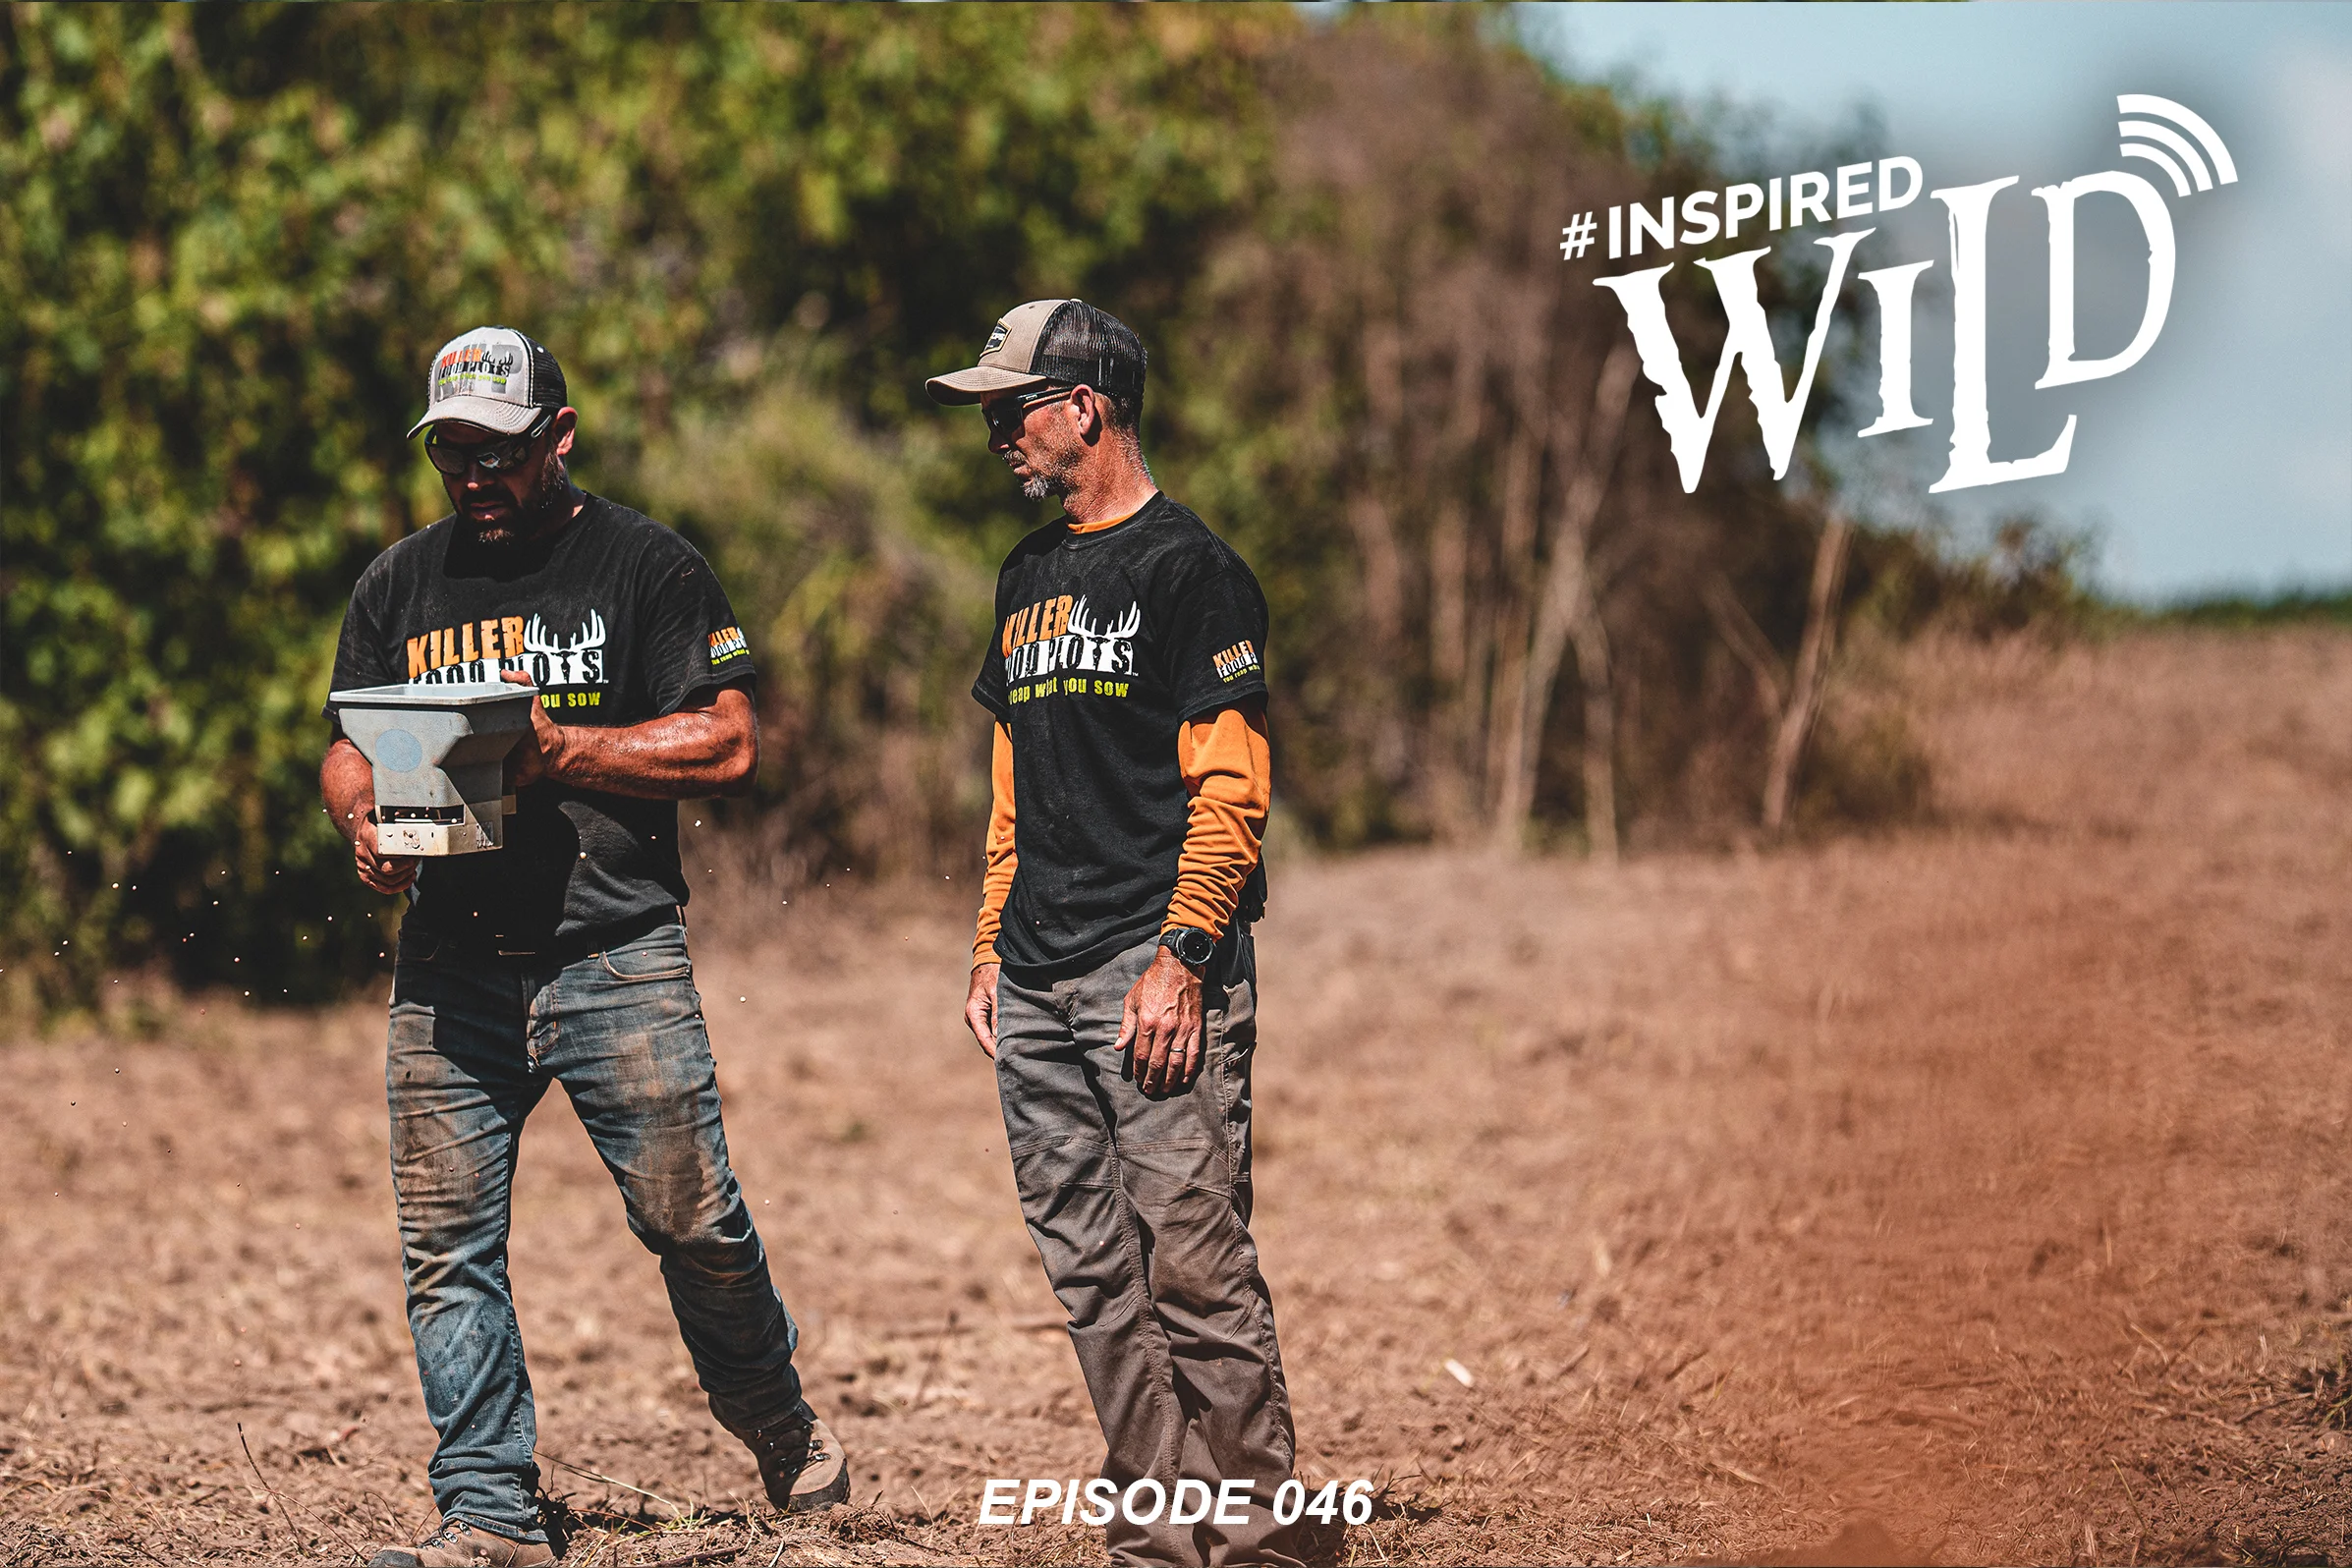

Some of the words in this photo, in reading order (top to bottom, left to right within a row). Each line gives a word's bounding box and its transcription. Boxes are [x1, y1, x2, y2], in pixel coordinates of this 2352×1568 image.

[440, 348, 482, 368] KILLER
[1002, 594, 1074, 658] KILLER
[407, 615, 525, 679] KILLER
[1218, 654, 1248, 678] FOOD
[568, 692, 601, 707] sow
[1063, 677, 1088, 696] you
[1094, 678, 1130, 699] sow
